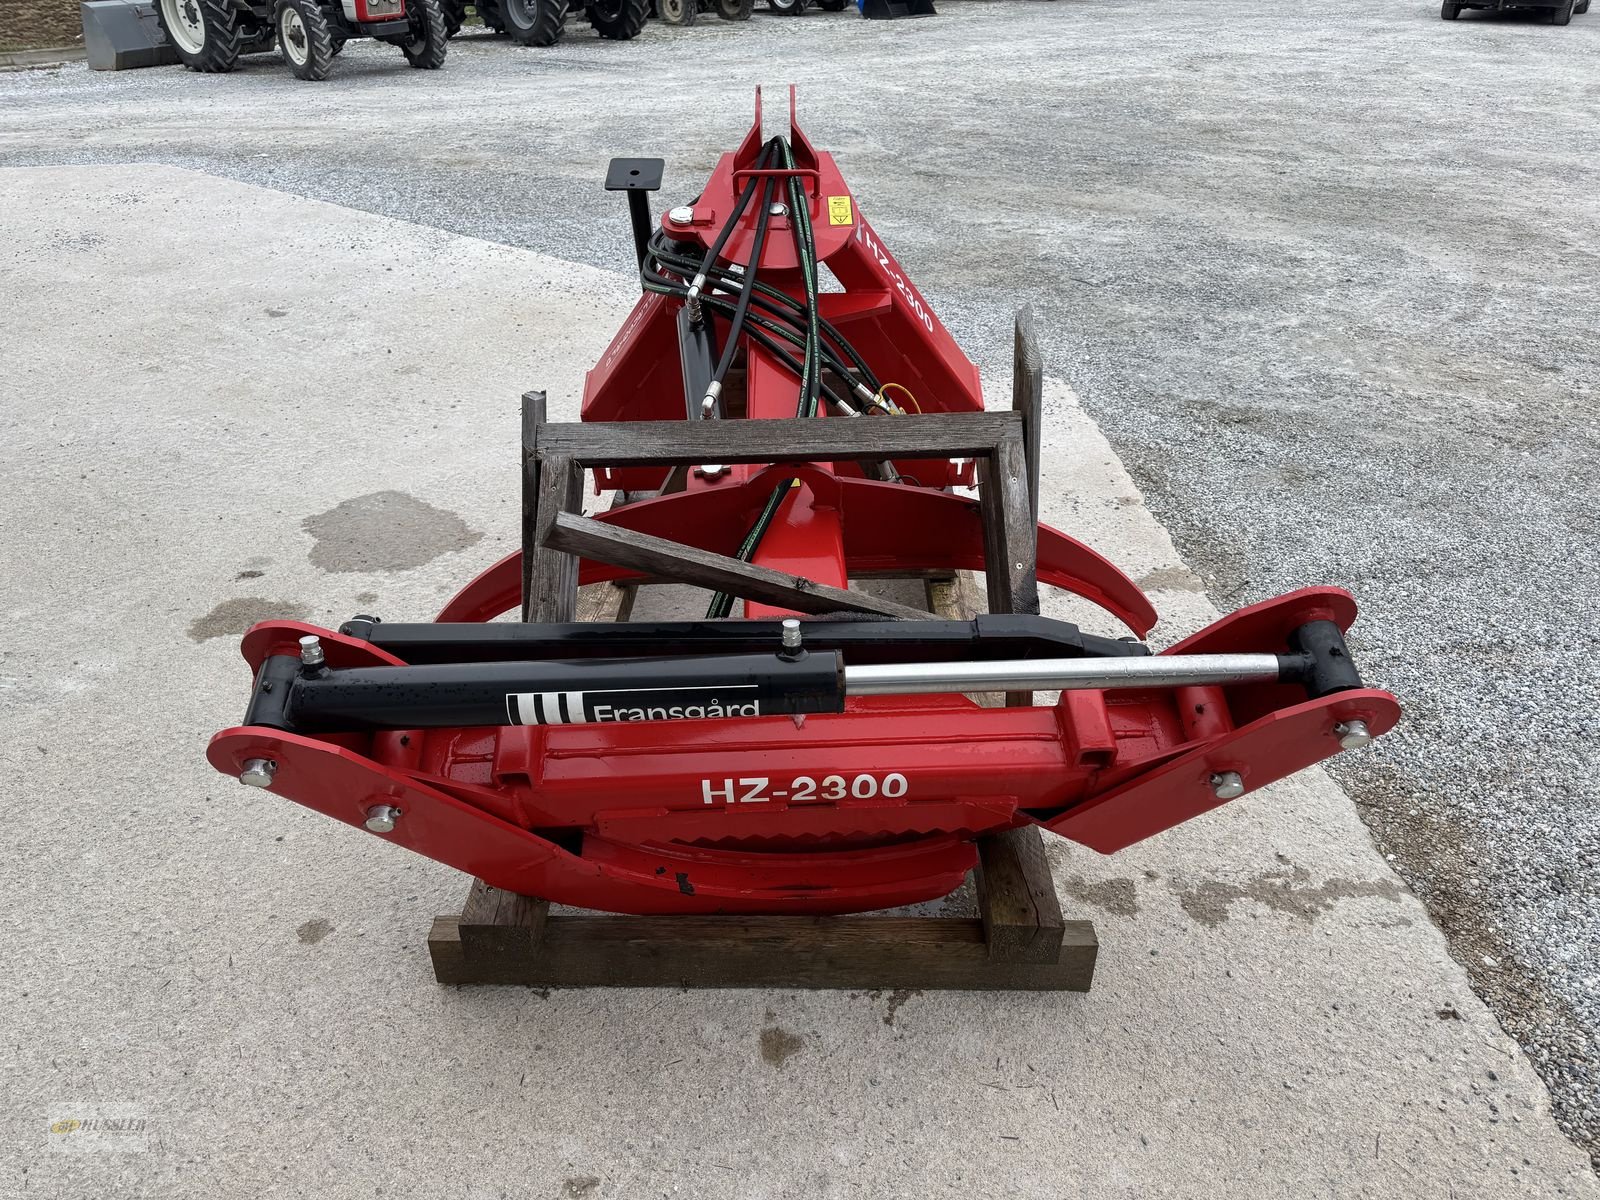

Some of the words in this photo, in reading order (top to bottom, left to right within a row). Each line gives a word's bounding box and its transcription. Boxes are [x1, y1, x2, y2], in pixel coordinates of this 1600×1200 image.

[865, 231, 934, 333] HZ-2300
[593, 698, 760, 722] Fransgård
[701, 772, 909, 804] HZ-2300
